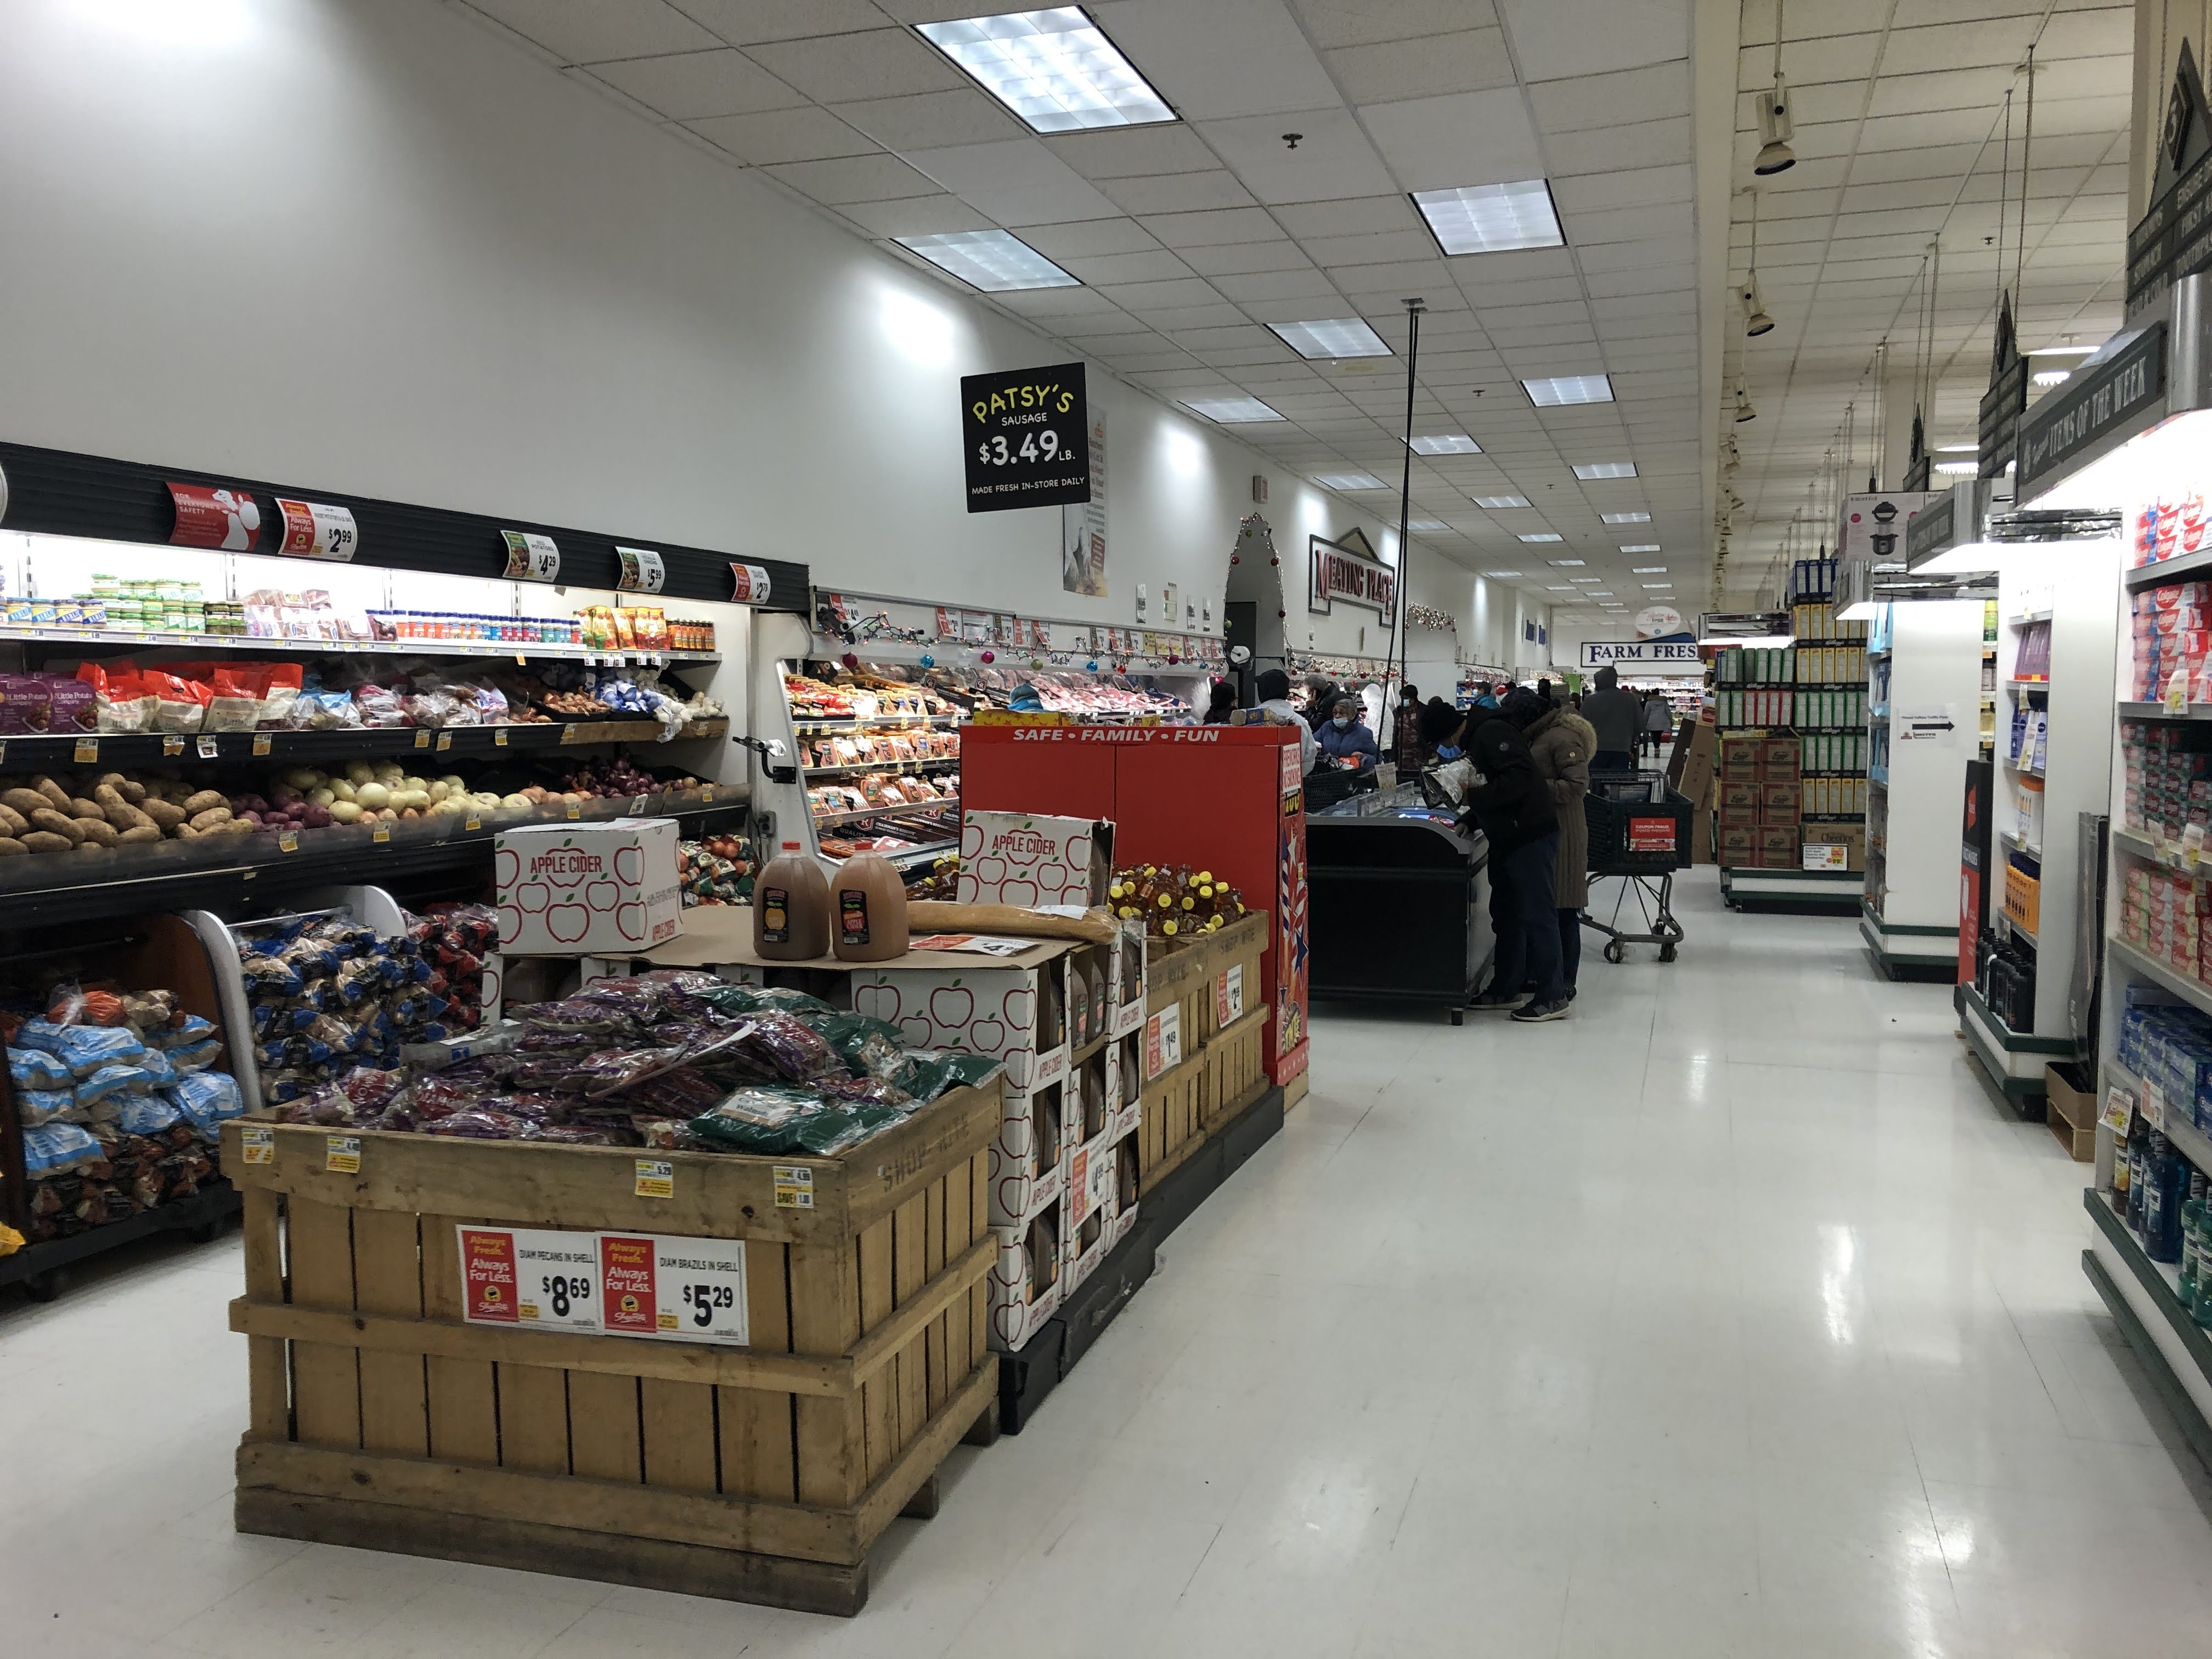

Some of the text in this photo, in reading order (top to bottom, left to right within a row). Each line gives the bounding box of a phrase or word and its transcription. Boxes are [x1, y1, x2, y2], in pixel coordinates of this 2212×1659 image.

[2092, 383, 2111, 428] THE
[2115, 357, 2146, 414] WEEK
[973, 384, 1074, 423] PATSY'S
[1001, 413, 1047, 426] SAUSAGE
[979, 430, 1075, 465] $3.49 LB.
[972, 477, 1085, 495] MADE FRESH IN-STORE DAILY
[179, 506, 205, 515] SAFETY
[1315, 550, 1392, 615] MEATING PLACE
[1589, 645, 1699, 662] FARM FRES
[1013, 730, 1219, 742] SAFE FAMILY FUN
[839, 827, 866, 838] QUALITY
[992, 835, 1056, 855] APPLE CIDER
[531, 856, 602, 873] APPLE CIDER
[470, 1236, 506, 1248] Always
[608, 1242, 647, 1255] Always
[471, 1258, 510, 1273] Always
[470, 1269, 513, 1283] For Less.
[608, 1266, 648, 1282] Always
[606, 1278, 652, 1293] For Less.
